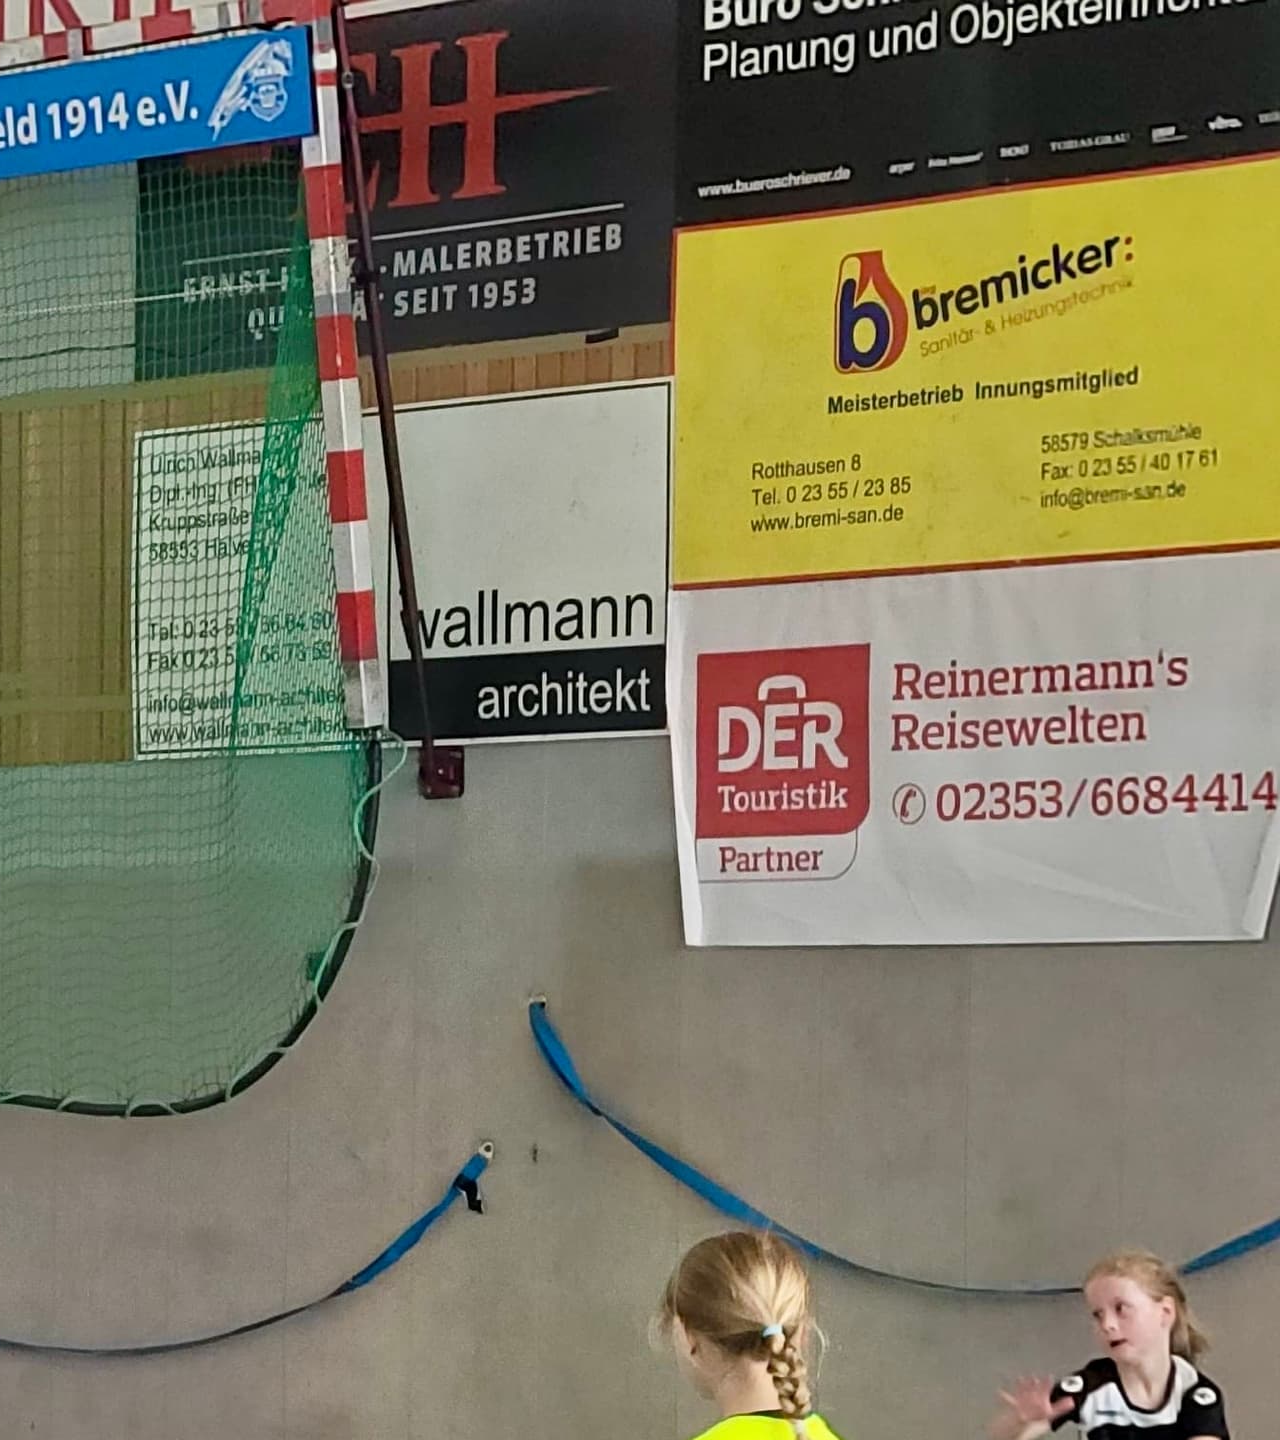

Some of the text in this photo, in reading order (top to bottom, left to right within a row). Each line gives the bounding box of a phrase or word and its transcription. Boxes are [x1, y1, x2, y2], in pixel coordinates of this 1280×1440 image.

[703, 9, 938, 82] Planung und
[45, 91, 130, 142] 1914
[136, 80, 200, 128] e.V.
[697, 166, 852, 198] www.bueroschriever.de
[392, 222, 623, 280] MALERBETRIEB
[393, 276, 538, 318] SEIT 1953
[984, 319, 996, 336] &
[826, 365, 1140, 415] Meisterbetrieb Innungsmitglied
[1040, 423, 1202, 454] 58579 Schalksmühle
[149, 448, 261, 476] Ulrich Wallma
[751, 453, 862, 481] Rotthausen 8
[1078, 459, 1088, 478] 0
[1092, 458, 1112, 477] 23
[1115, 455, 1137, 475] 55
[1149, 453, 1171, 471] 40
[1177, 450, 1195, 470] 17
[1198, 448, 1218, 468] 61
[751, 475, 912, 506] Tel. 0 23 55 23 85
[148, 507, 250, 534] Kruppstraße
[750, 503, 904, 533] www.bremi-san.de
[477, 667, 651, 720] architekt
[891, 649, 1189, 703] Reinermann's
[717, 700, 849, 774] DER
[890, 704, 1148, 753] Reisewelten
[717, 779, 849, 814] Touristik
[935, 770, 1278, 823] 02353/6684414
[717, 844, 824, 874] Partner
